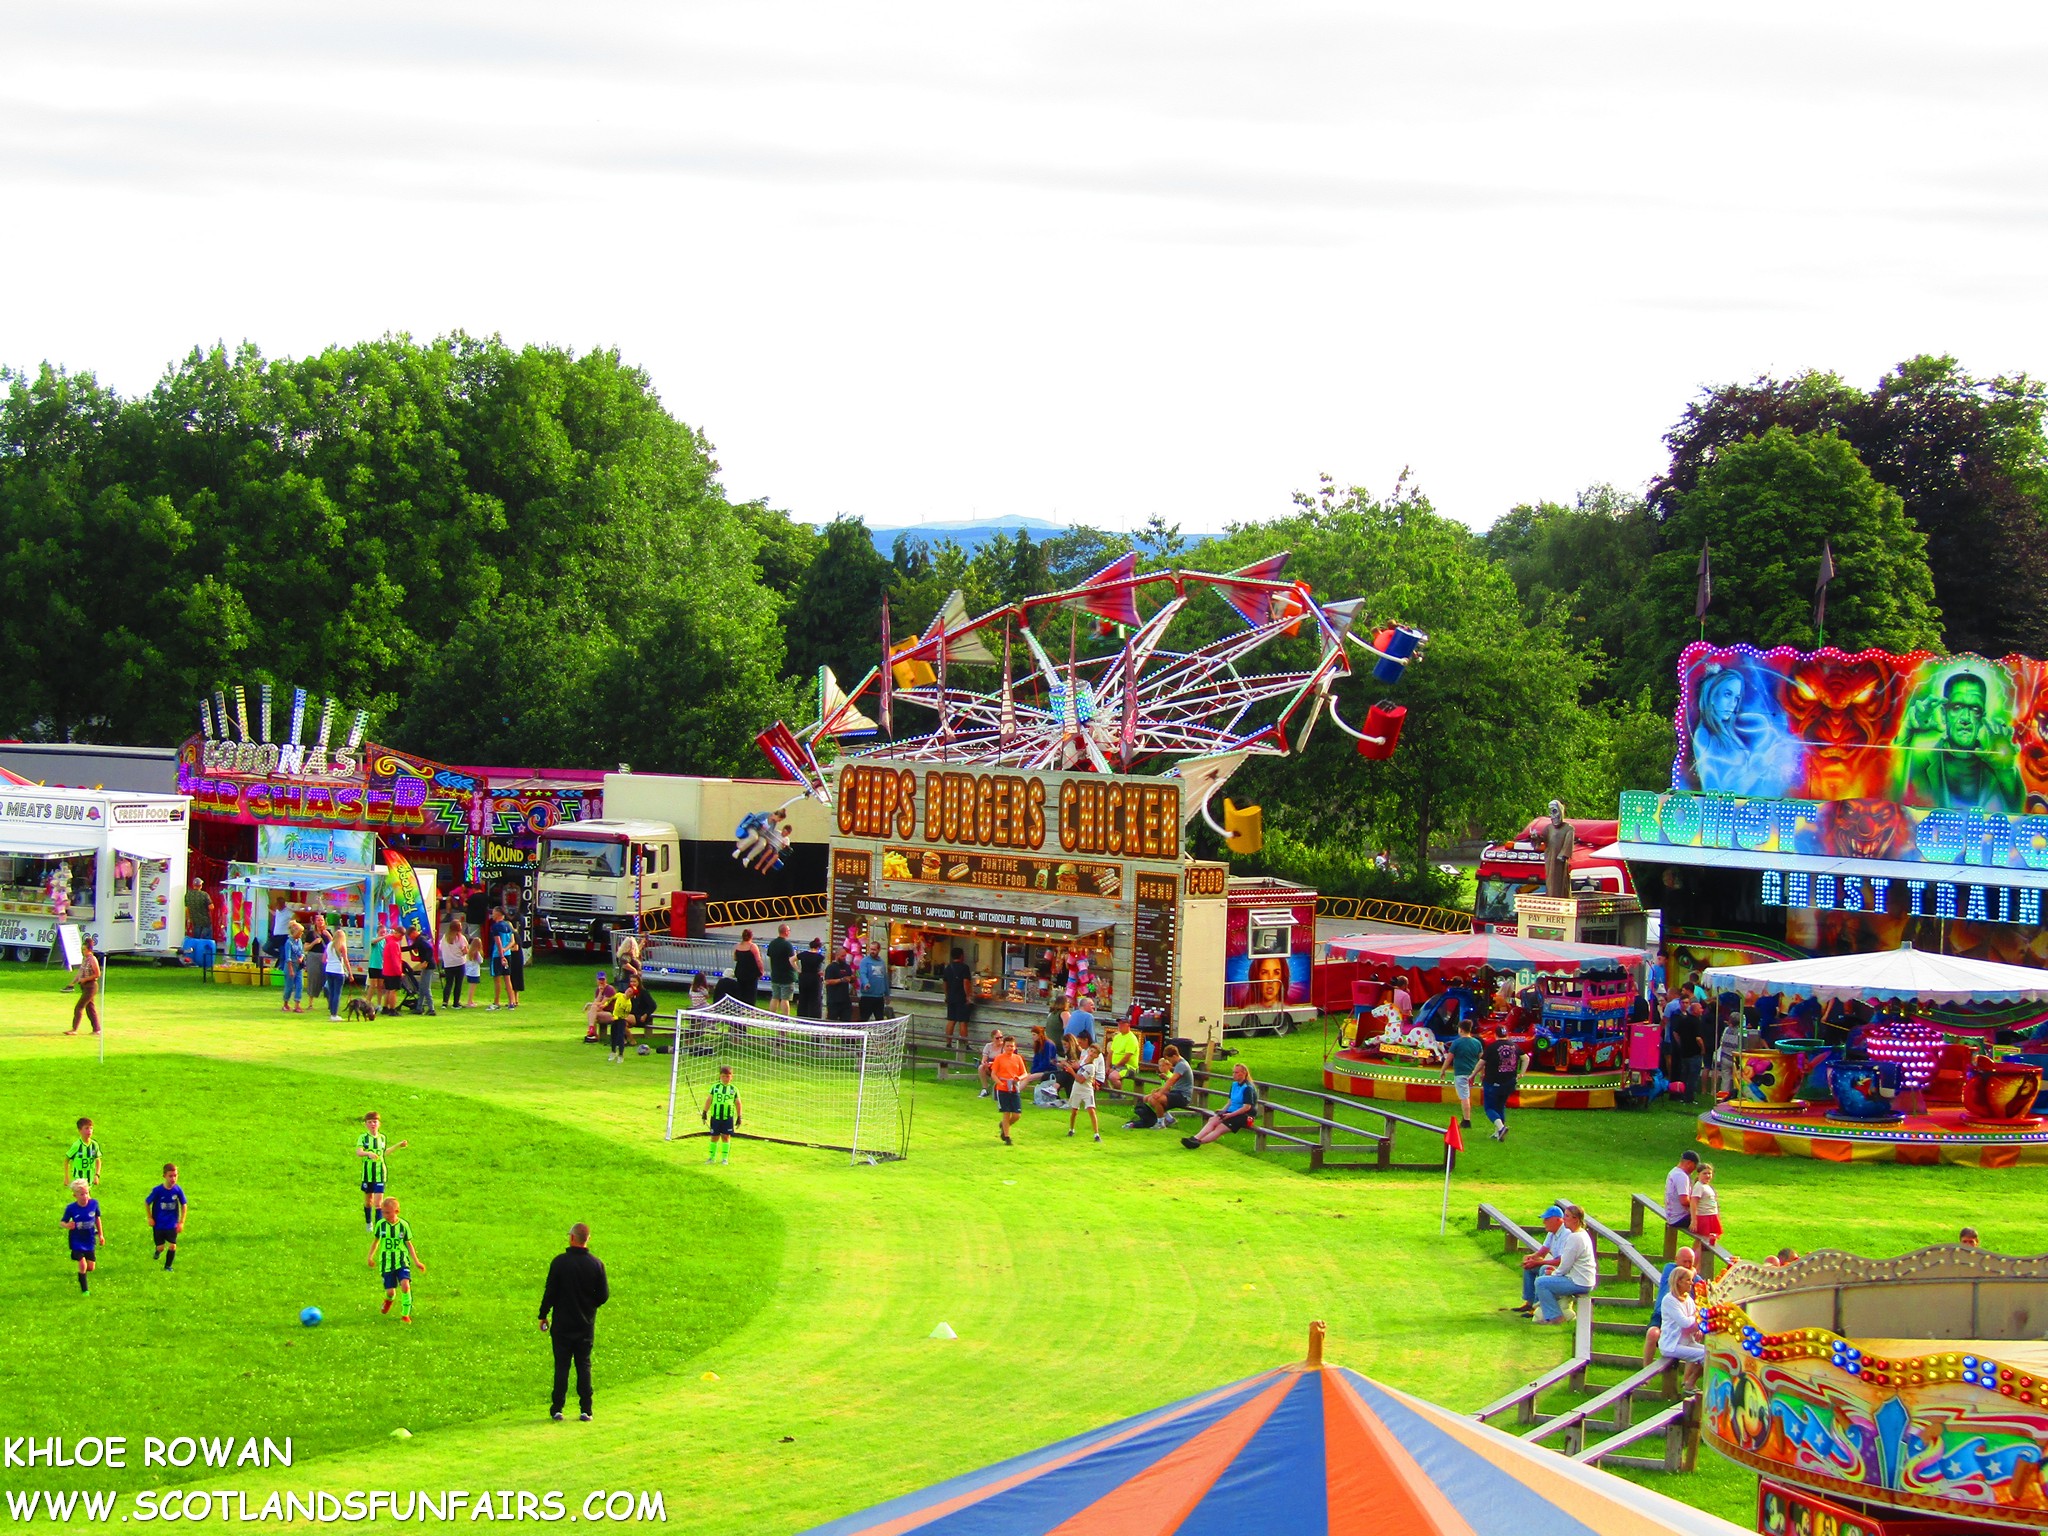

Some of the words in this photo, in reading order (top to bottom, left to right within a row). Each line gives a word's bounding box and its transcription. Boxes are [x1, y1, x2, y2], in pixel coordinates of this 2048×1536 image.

[246, 775, 430, 826] CHASER
[6, 802, 52, 818] MEATS
[55, 805, 84, 821] BUN
[118, 809, 144, 819] FRESH
[146, 808, 169, 819] FOOD
[838, 764, 916, 840] CHIPS
[924, 771, 1046, 850] BURGERS
[1059, 778, 1180, 860] CHICKEN
[1620, 789, 1818, 853] Roller
[488, 841, 524, 863] ROUND
[836, 858, 867, 876] MENU
[981, 857, 1019, 872] FUNTIME
[972, 873, 1004, 886] STREET
[1005, 874, 1027, 888] FOOD
[1189, 868, 1225, 895] FOOD
[1140, 881, 1173, 900] MENU
[1761, 870, 1890, 915] GHOST
[1906, 879, 2041, 925] TRAIN
[857, 900, 869, 910] COLD
[870, 901, 887, 912] DRINKS
[891, 904, 908, 914] COFFEE
[912, 905, 922, 915] TEA
[925, 907, 956, 919] CAPPUCCINO
[959, 910, 974, 920] LATTE
[978, 913, 989, 922] HOT
[989, 914, 1015, 924] CHOCOLATE
[1020, 916, 1038, 926] BOVRIL
[1042, 917, 1055, 928] COLD
[1055, 919, 1072, 930] WATER
[1546, 915, 1566, 924] HERE
[1586, 916, 1596, 924] PAY
[142, 938, 161, 946] TASTY
